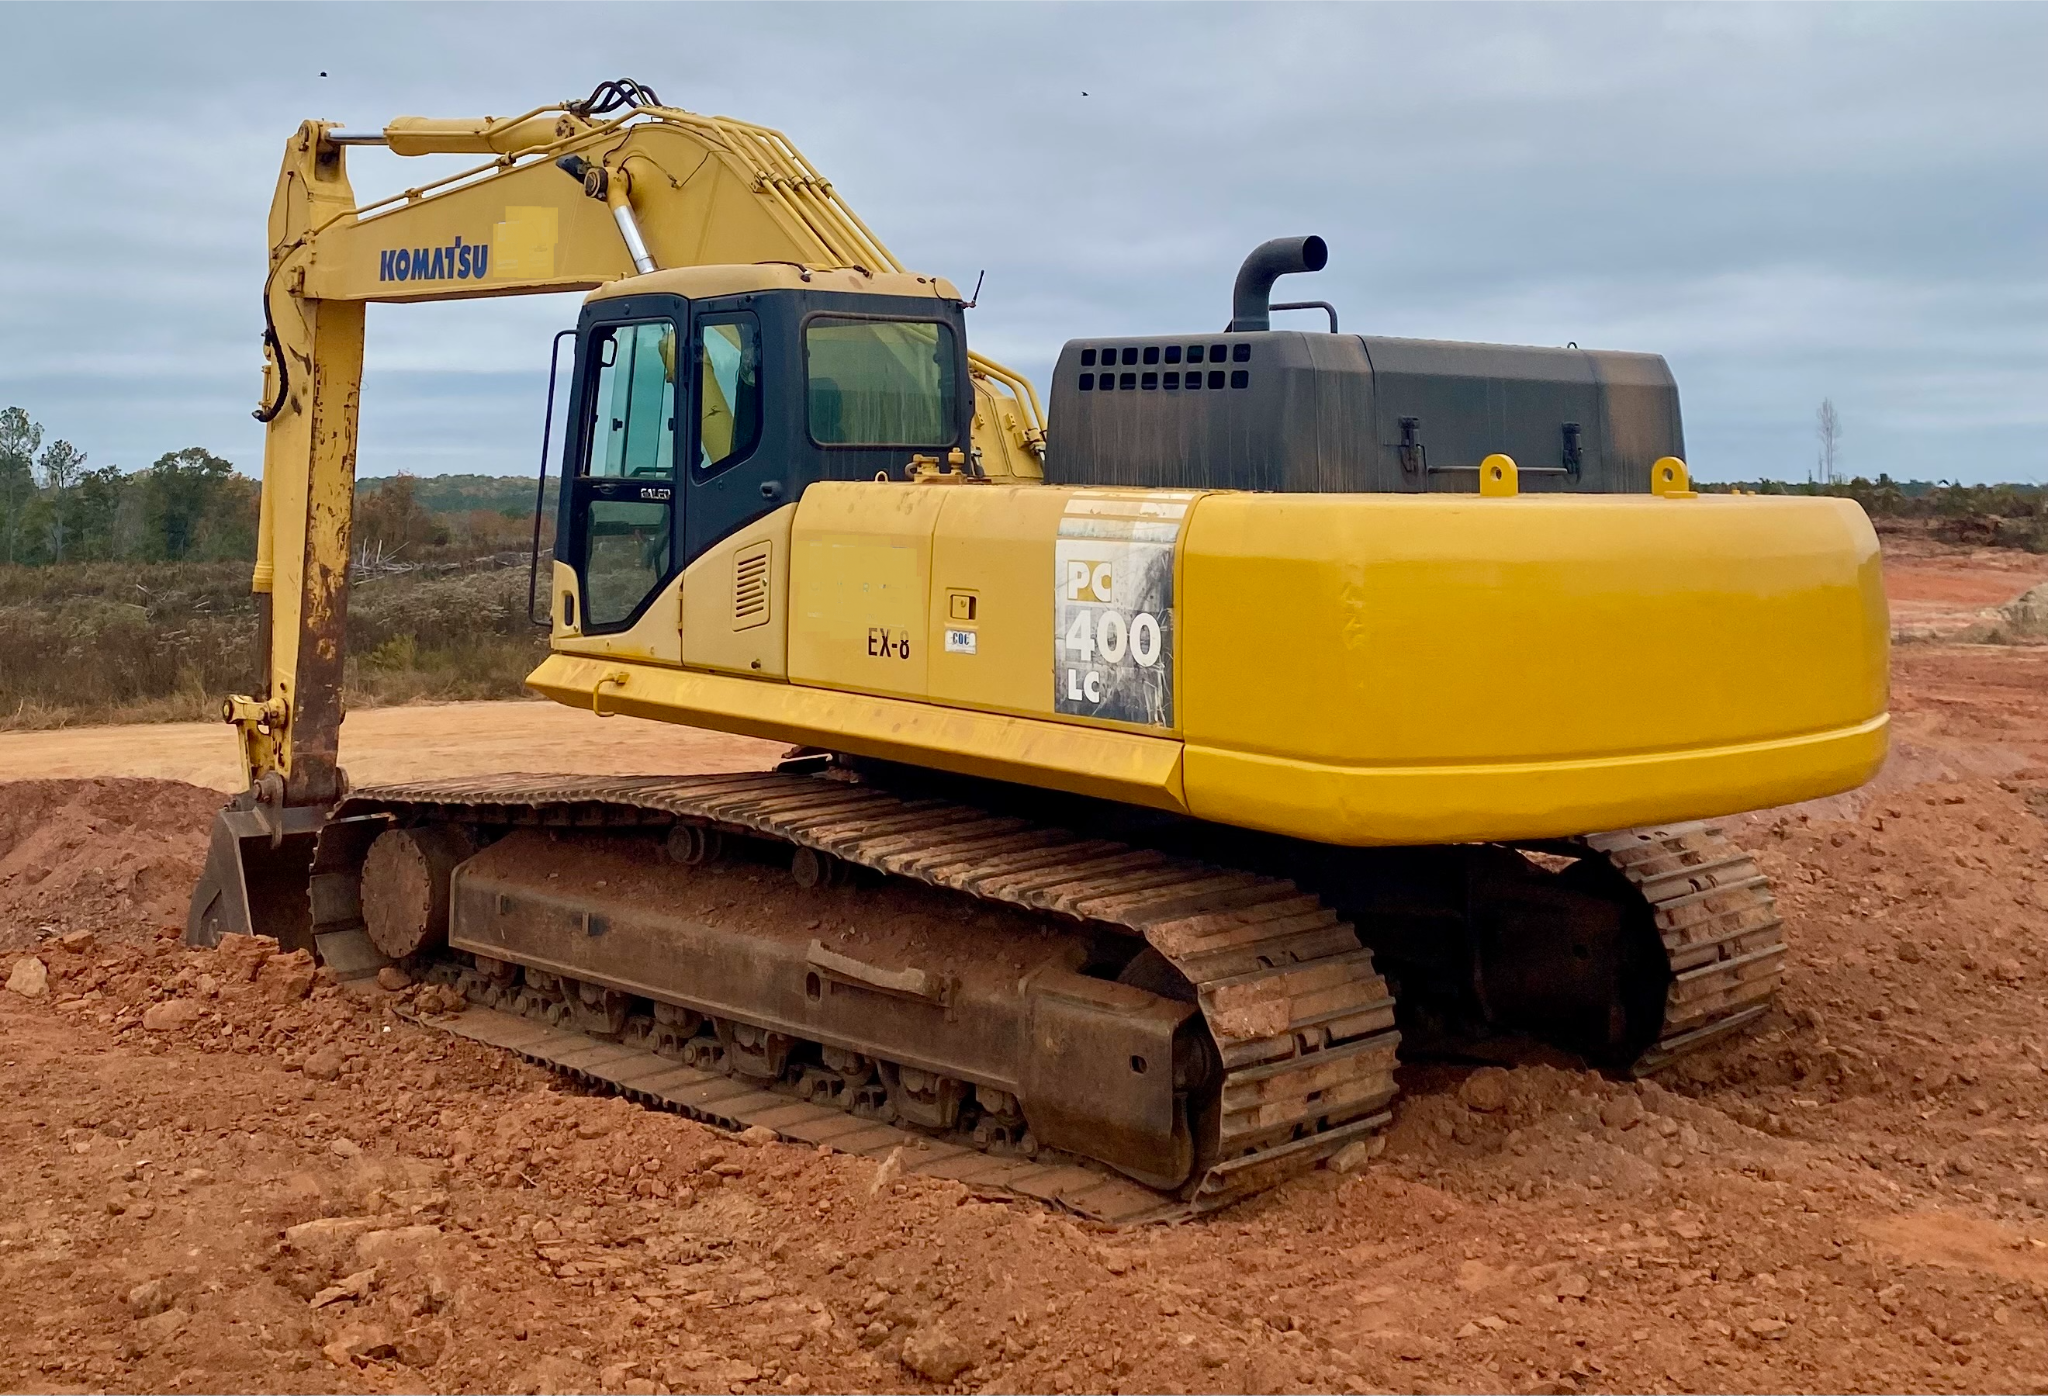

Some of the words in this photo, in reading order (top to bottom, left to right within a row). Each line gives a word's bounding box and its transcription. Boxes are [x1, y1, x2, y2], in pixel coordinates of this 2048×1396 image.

[380, 236, 488, 282] KOMATSU
[1067, 560, 1112, 602] PC
[868, 627, 910, 660] EX-8
[1065, 609, 1161, 667] 400
[1067, 668, 1100, 704] LC
